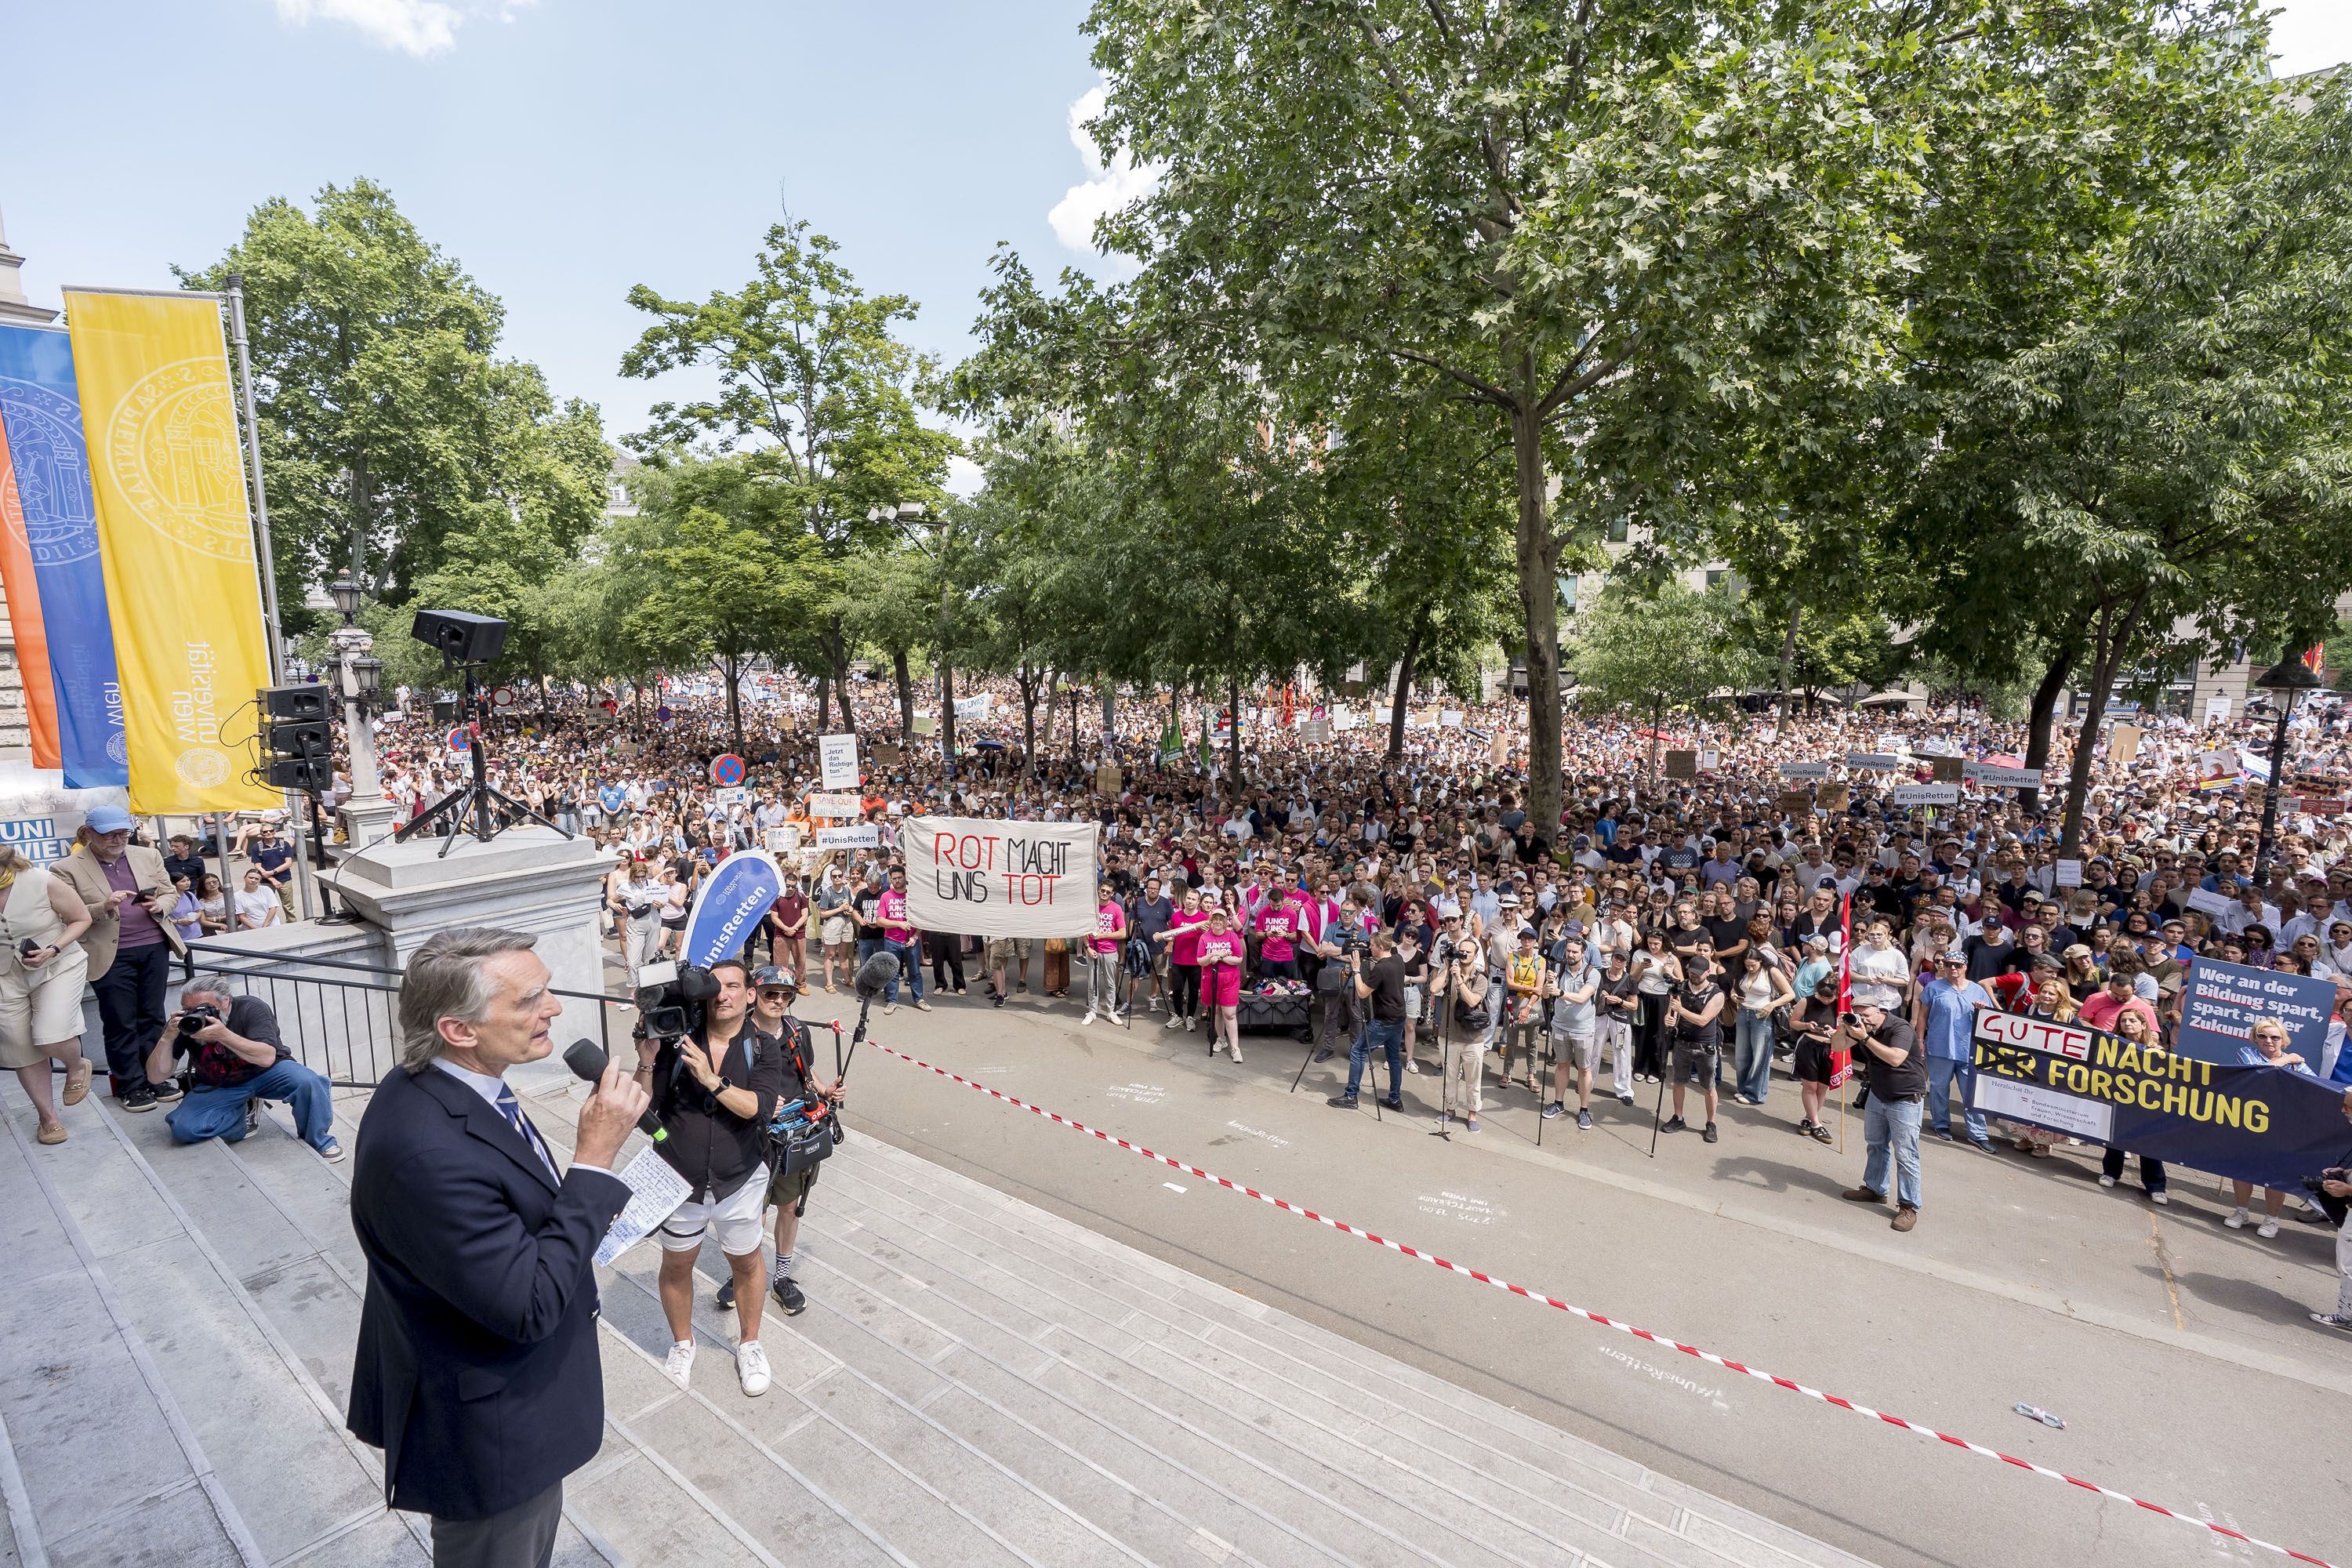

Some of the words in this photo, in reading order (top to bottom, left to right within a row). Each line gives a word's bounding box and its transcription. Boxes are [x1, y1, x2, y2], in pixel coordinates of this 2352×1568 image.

[1849, 760, 1895, 768] #UnisRetten
[1982, 774, 2039, 784] #UnisRetten
[817, 796, 836, 804] SAVE
[837, 796, 854, 806] OUR
[1, 818, 53, 840] UNI
[935, 832, 1000, 870] ROT
[1007, 838, 1071, 875] MACHT
[936, 869, 988, 903] UNIS
[1001, 873, 1062, 906] TOT
[2199, 967, 2235, 985] Wer
[2238, 977, 2261, 990] an
[2264, 980, 2298, 996] der
[2192, 1001, 2241, 1020] spart
[2195, 982, 2264, 1011] Bildung
[2267, 999, 2324, 1023] spart,
[2189, 1014, 2252, 1040] Zukunf
[1983, 1014, 2087, 1059] GUTE
[2096, 1036, 2220, 1086] NACHT
[1991, 1080, 2023, 1093] Herzlichst
[2048, 1059, 2270, 1133] FORSCHUNG
[811, 1106, 826, 1120] ORF
[2031, 1099, 2089, 1118] Bundesministerium
[2031, 1105, 2053, 1116] Frauen,
[2055, 1112, 2096, 1127] Wissenschaft
[2043, 1115, 2074, 1128] Forschung
